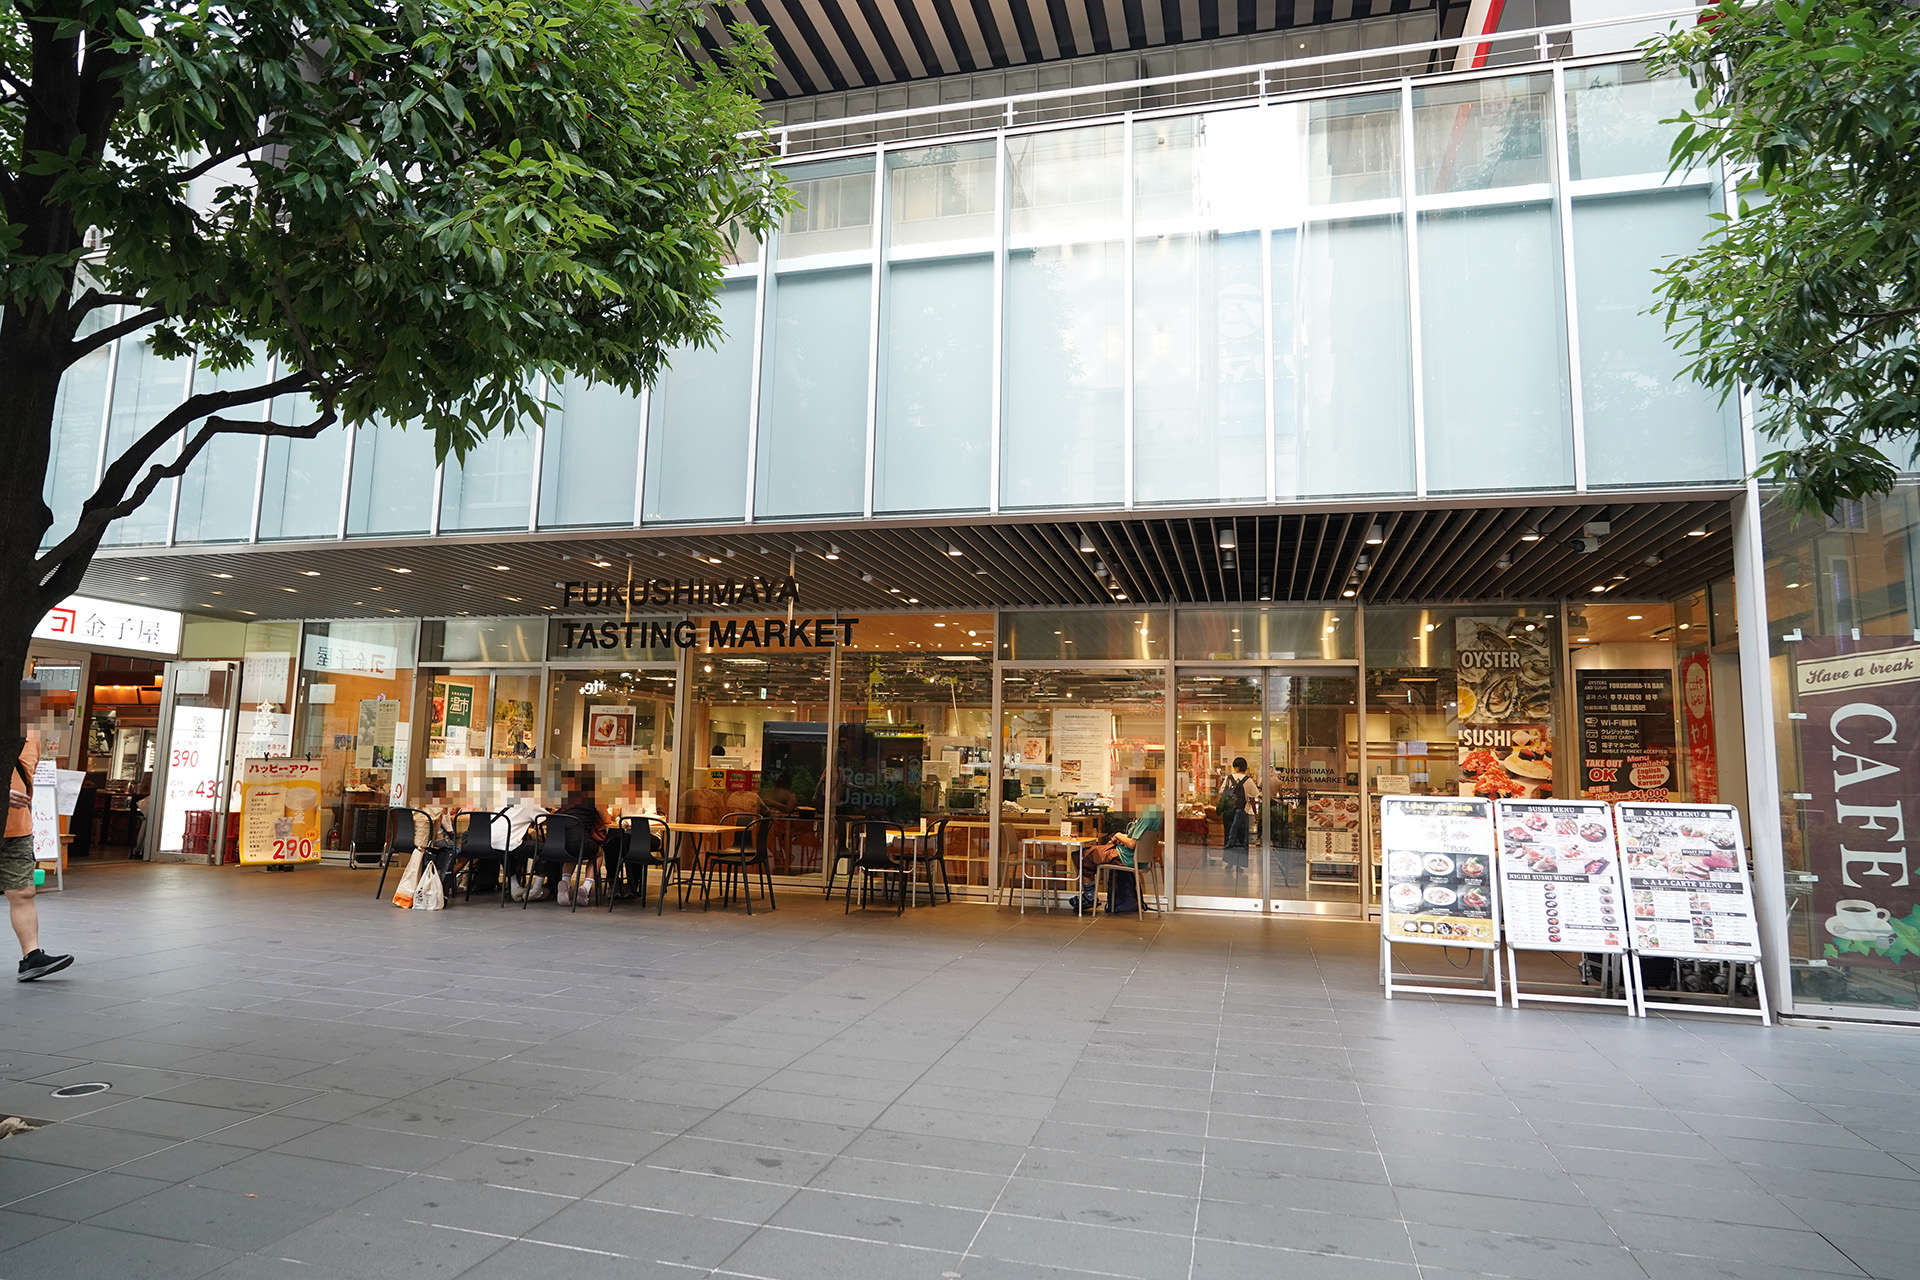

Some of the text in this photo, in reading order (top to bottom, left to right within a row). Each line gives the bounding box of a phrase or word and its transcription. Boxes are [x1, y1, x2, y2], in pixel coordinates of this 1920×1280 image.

[563, 575, 800, 607] FUKUSHIMAYA
[81, 613, 160, 645] 金子屋
[562, 618, 859, 650] TASTING MARKET
[1461, 651, 1521, 668] OYSTER
[1805, 657, 1914, 684] Have a break
[1463, 729, 1511, 747] SUSHI
[172, 750, 198, 767] 390
[1585, 759, 1623, 768] TAKE OUT
[1627, 755, 1650, 763] Menu
[1632, 760, 1670, 769] available
[249, 764, 318, 774] ハッピーアワー
[1589, 768, 1618, 782] OK
[1315, 776, 1346, 784] MARKET
[841, 787, 896, 809] Japan
[1630, 788, 1668, 799] ¥1,000
[1829, 702, 1910, 889] CAFE
